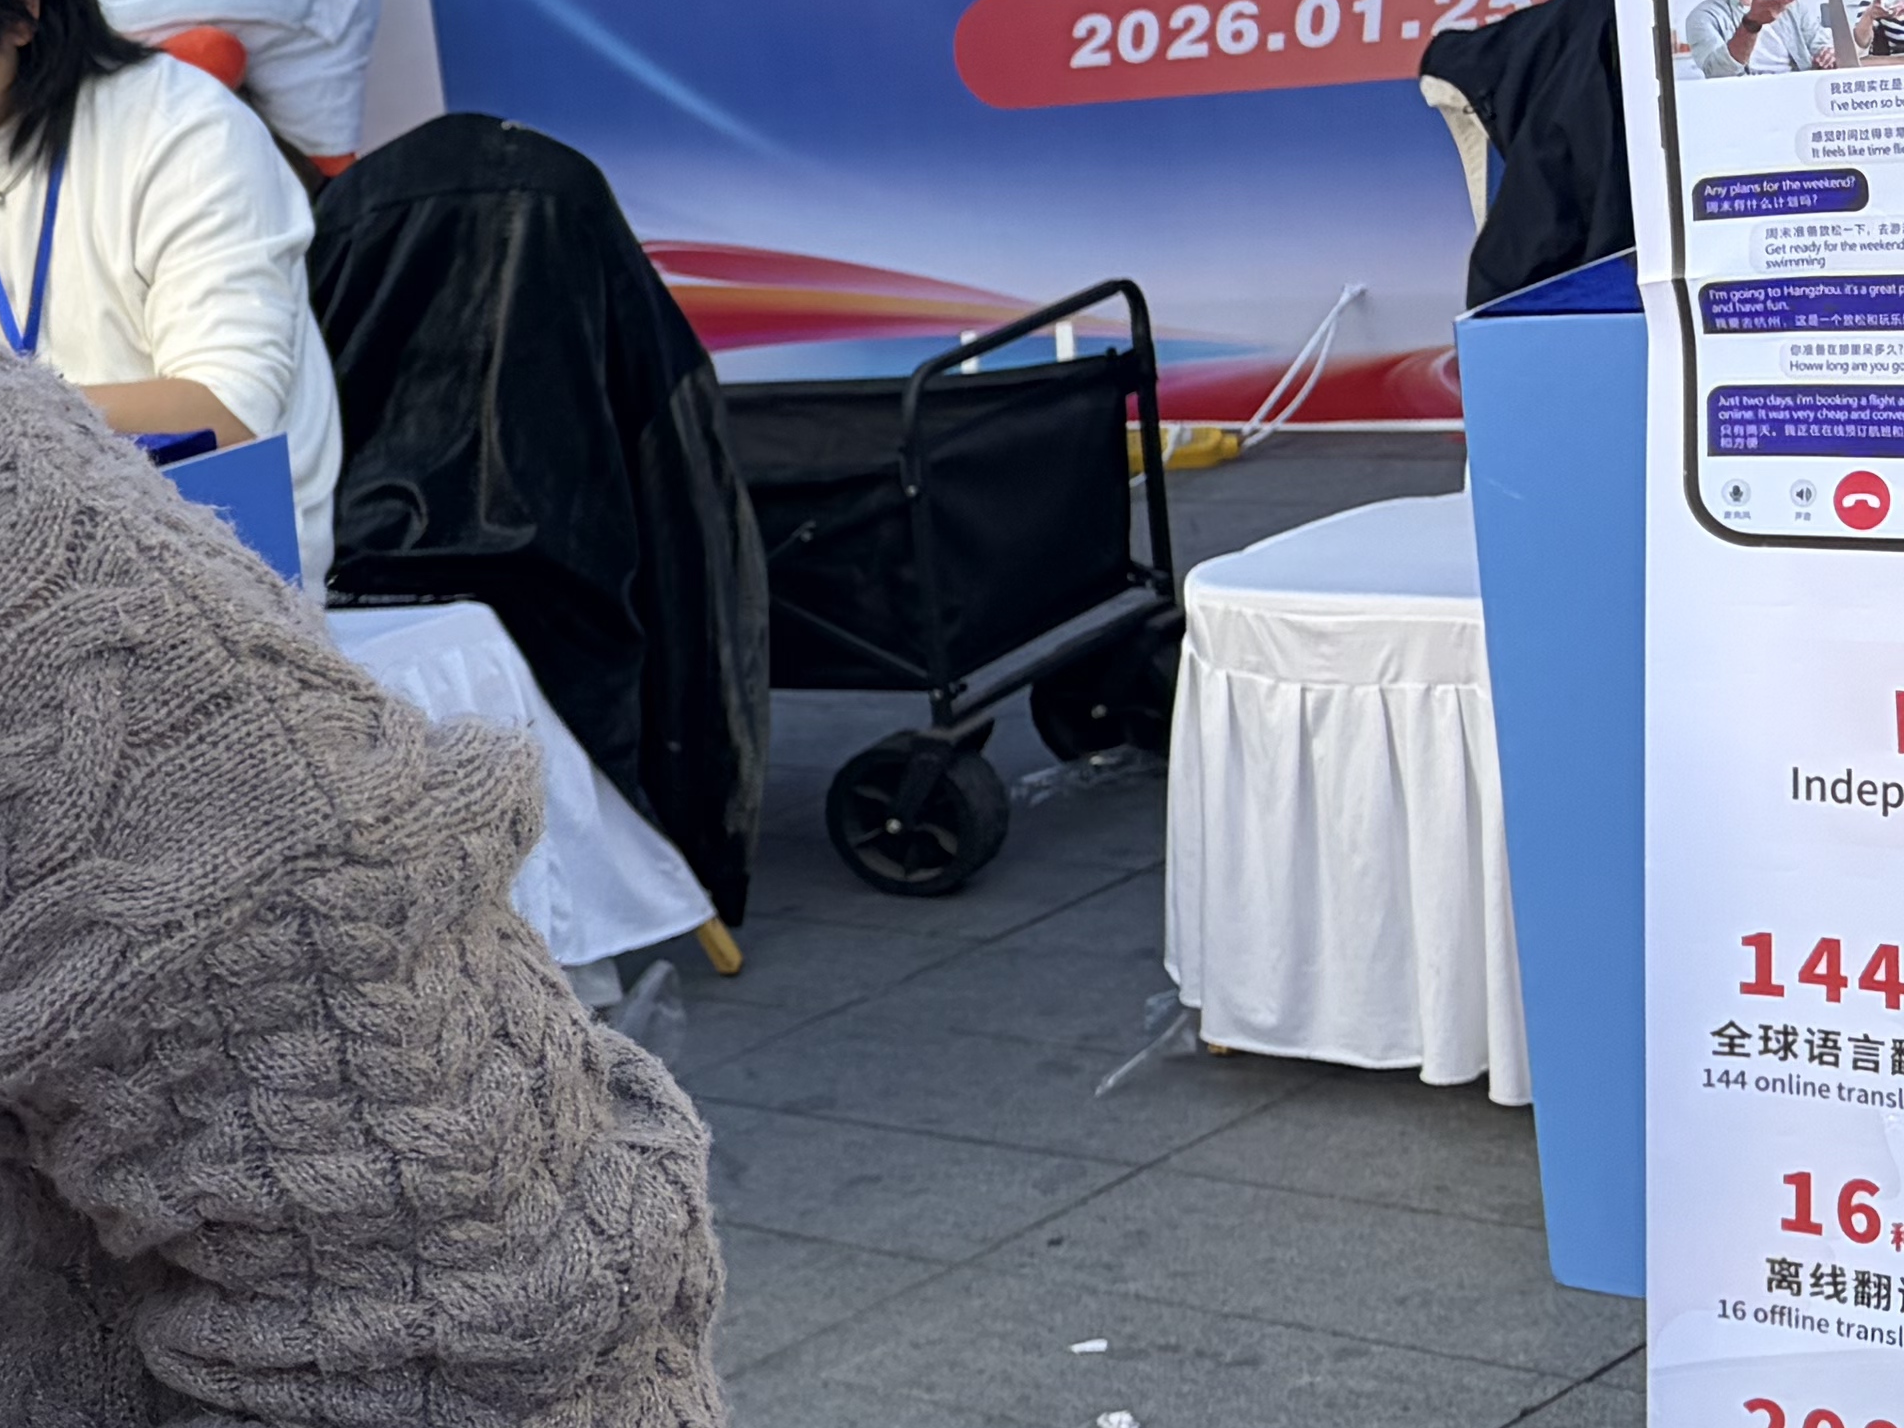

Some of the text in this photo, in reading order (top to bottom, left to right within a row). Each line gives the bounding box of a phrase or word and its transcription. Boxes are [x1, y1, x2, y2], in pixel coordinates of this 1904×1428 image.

[1739, 932, 1904, 1010] 144
[1702, 1068, 1748, 1090] 144
[1755, 1072, 1831, 1101] online
[1765, 1256, 1904, 1314] 离线翻
[1717, 1298, 1830, 1335] 16 offline
